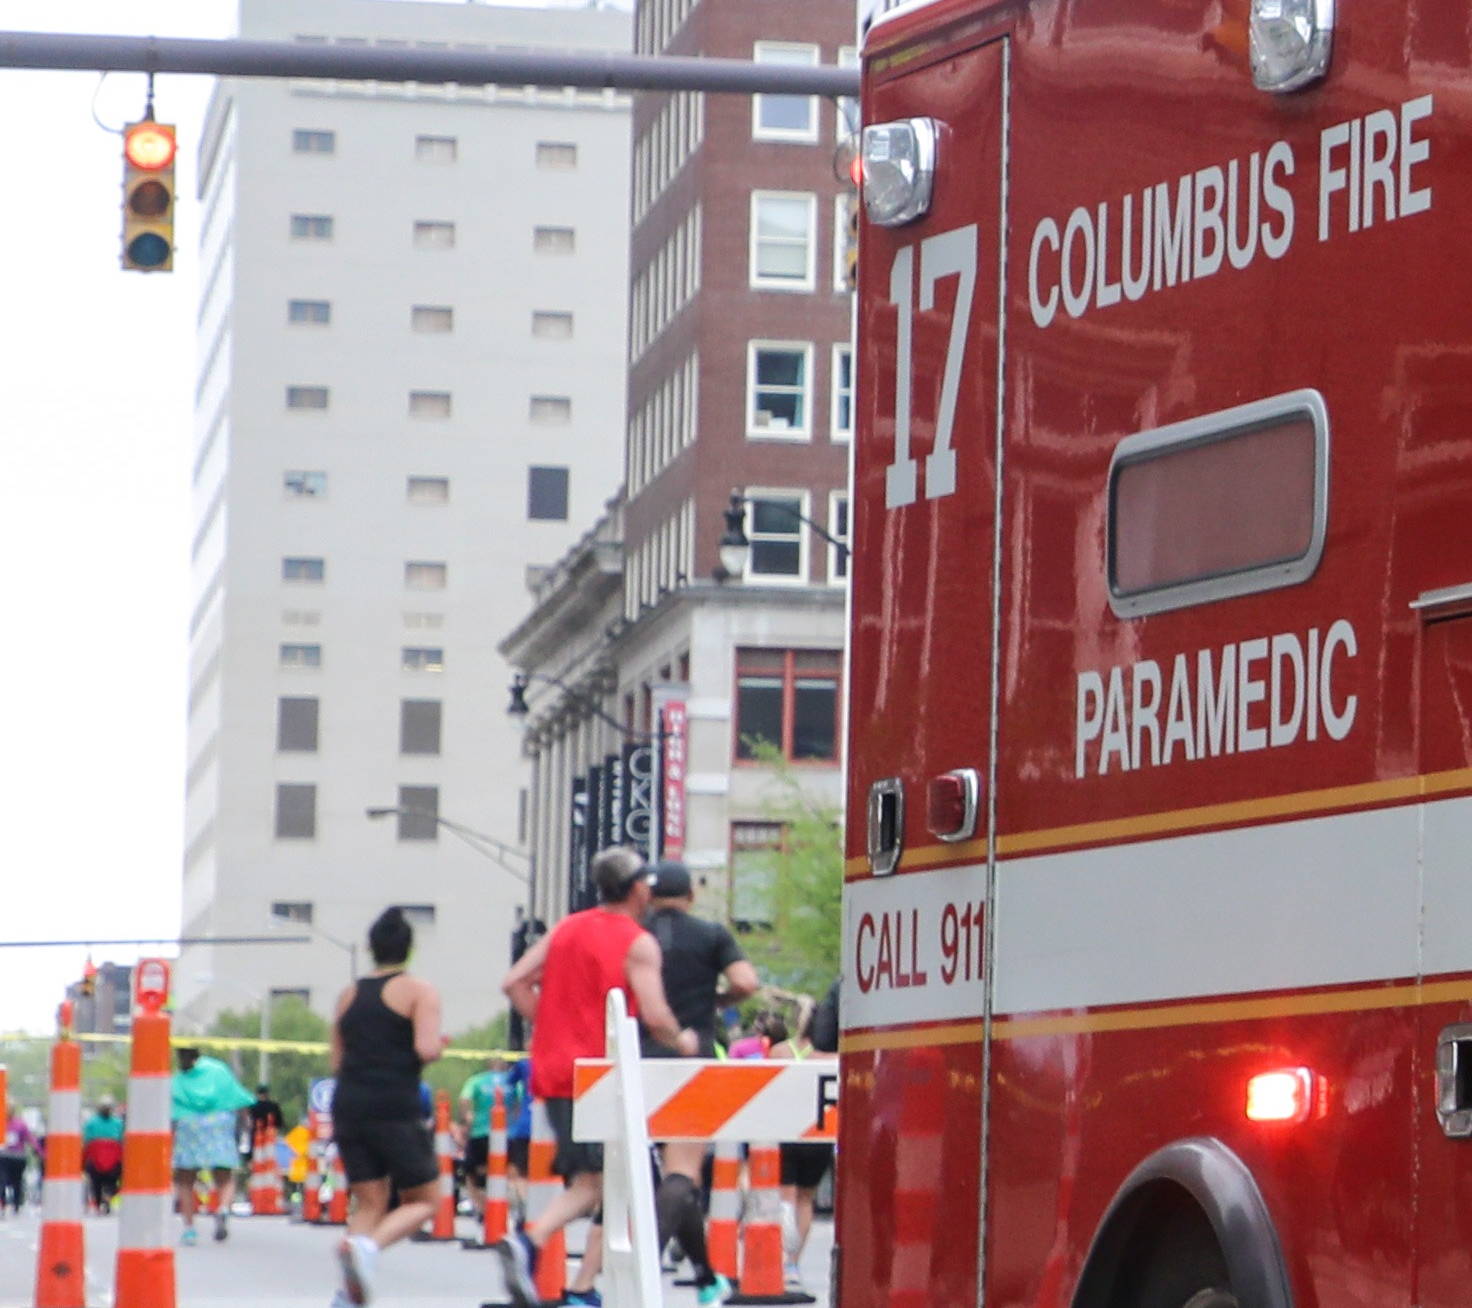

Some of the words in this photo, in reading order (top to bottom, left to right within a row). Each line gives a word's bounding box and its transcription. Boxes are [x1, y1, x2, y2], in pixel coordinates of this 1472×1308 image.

[1029, 142, 1295, 327] COLUMBUS
[1318, 94, 1432, 241] FIRE
[886, 224, 978, 514] 17
[1075, 620, 1357, 778] PARAMEDIC
[856, 904, 928, 994] CALL
[940, 898, 986, 983] 911
